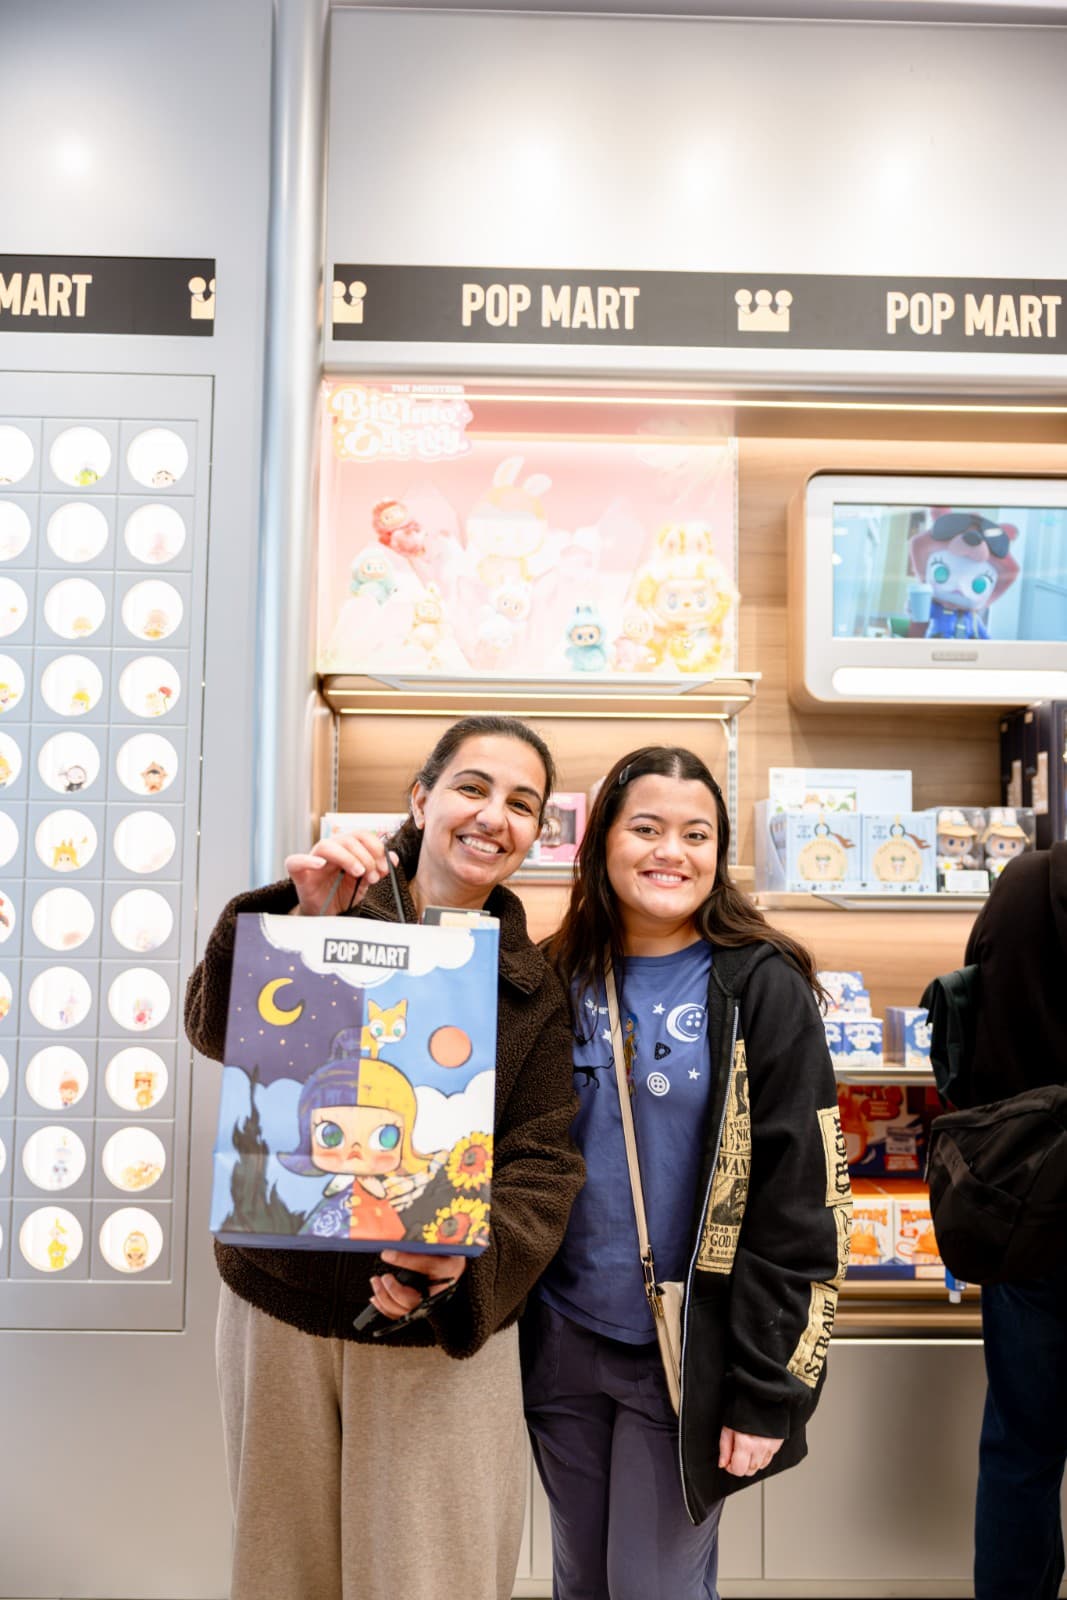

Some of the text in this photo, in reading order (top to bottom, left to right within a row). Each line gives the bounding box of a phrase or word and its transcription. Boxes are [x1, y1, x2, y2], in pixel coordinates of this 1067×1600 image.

[462, 283, 641, 330] POP MART
[886, 291, 1062, 338] POP MART
[326, 941, 407, 968] POP MART
